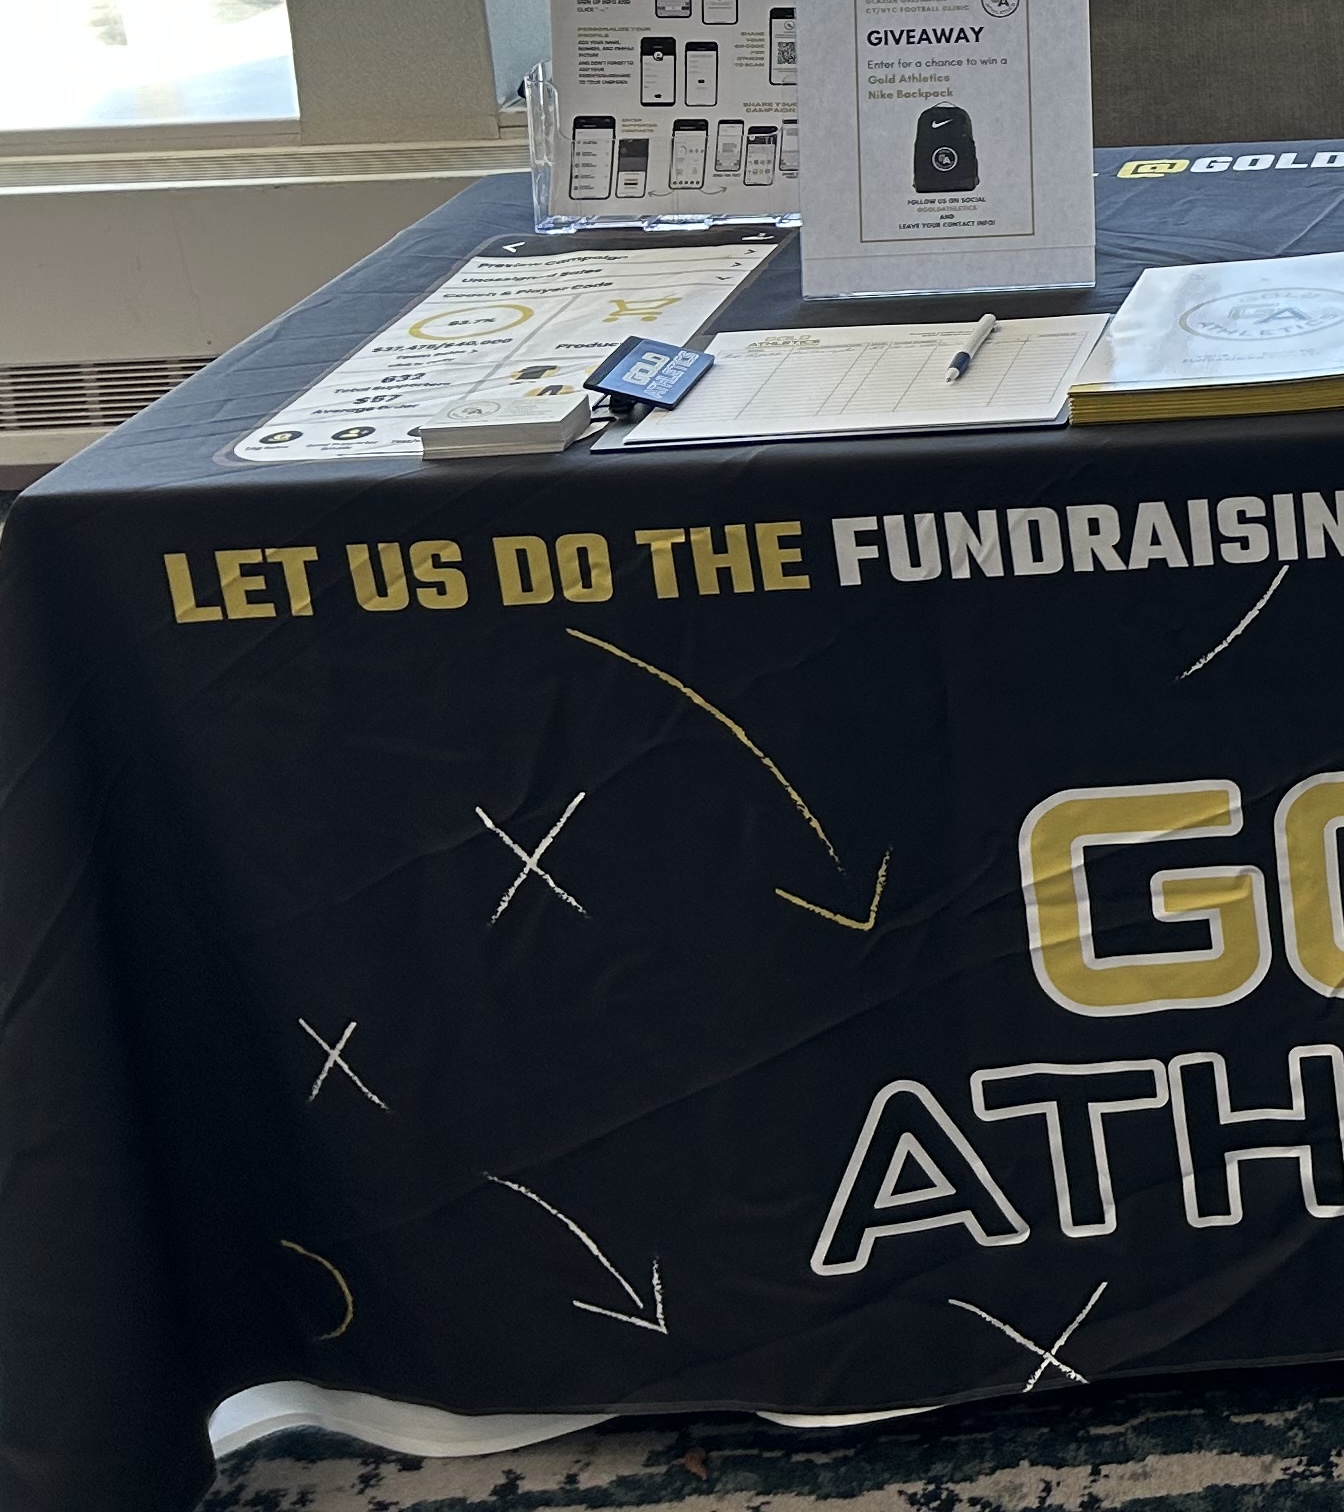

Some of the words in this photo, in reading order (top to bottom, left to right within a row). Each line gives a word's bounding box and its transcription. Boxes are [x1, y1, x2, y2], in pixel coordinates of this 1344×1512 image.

[866, 26, 985, 46] GIVEAWAY
[867, 59, 895, 69] Enter
[898, 58, 913, 68] for
[925, 57, 964, 68] chance
[966, 58, 977, 66] to
[979, 57, 998, 65] win
[1000, 57, 1008, 65] a
[867, 74, 896, 85] Gold
[898, 73, 950, 84] Athletics
[867, 89, 894, 99] Nike
[896, 87, 954, 100] Backpack
[545, 255, 628, 266] Campaign
[515, 286, 571, 295] Player
[571, 281, 613, 289] Code
[1198, 313, 1338, 336] ATHLETICS
[622, 352, 670, 385] GOLD
[643, 350, 699, 398] ATHLETICS
[372, 382, 451, 391] Supporters
[311, 405, 374, 414] Average
[163, 546, 317, 624] LET
[353, 540, 466, 612] US
[498, 533, 611, 607] DO
[634, 521, 811, 600] THE
